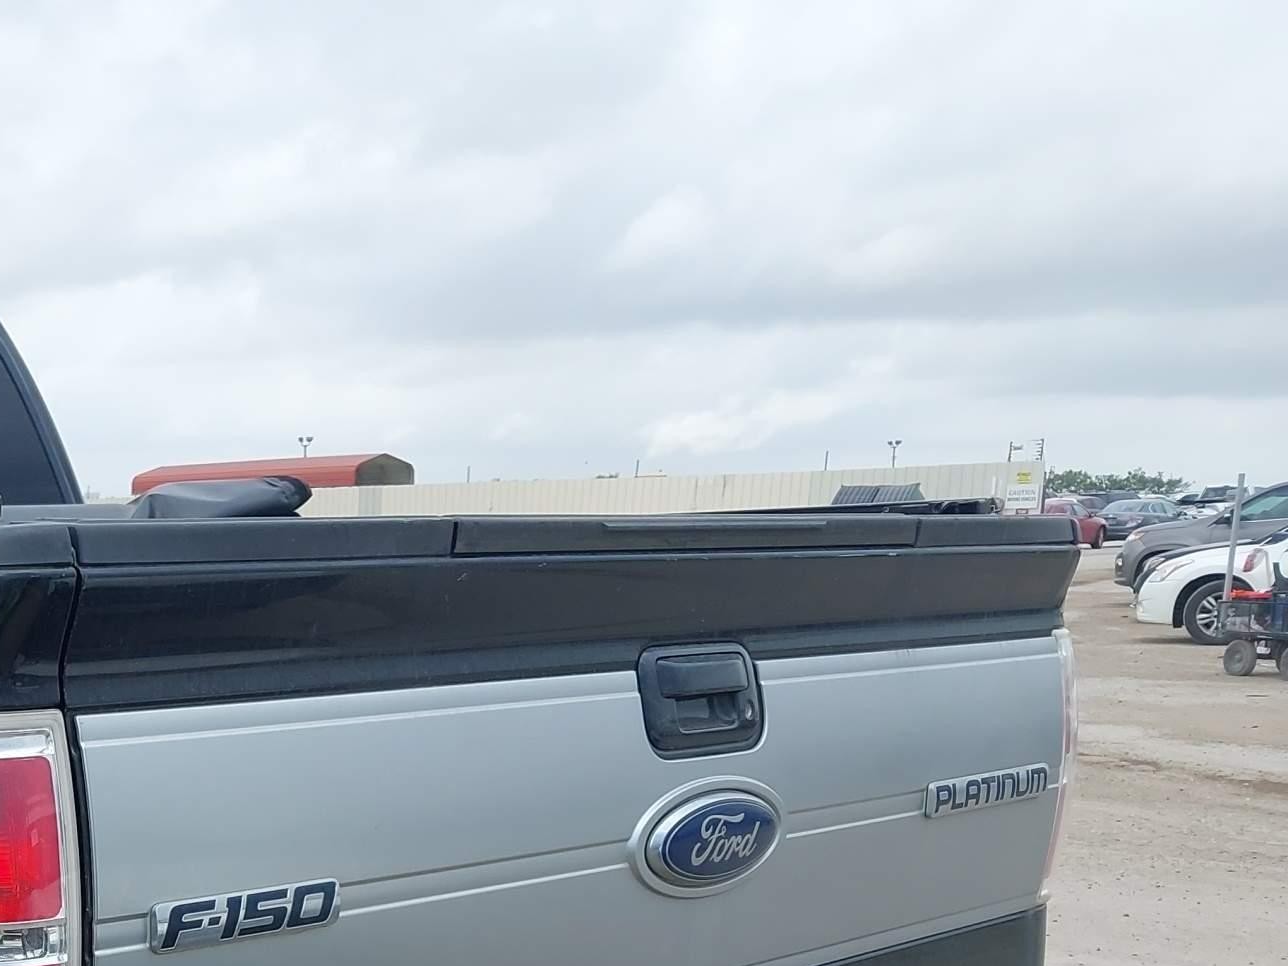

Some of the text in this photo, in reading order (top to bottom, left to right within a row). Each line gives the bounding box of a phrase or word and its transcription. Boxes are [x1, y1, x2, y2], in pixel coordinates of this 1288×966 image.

[934, 766, 1048, 814] PLATINUM
[690, 812, 761, 867] Ford
[159, 880, 337, 950] F-150
